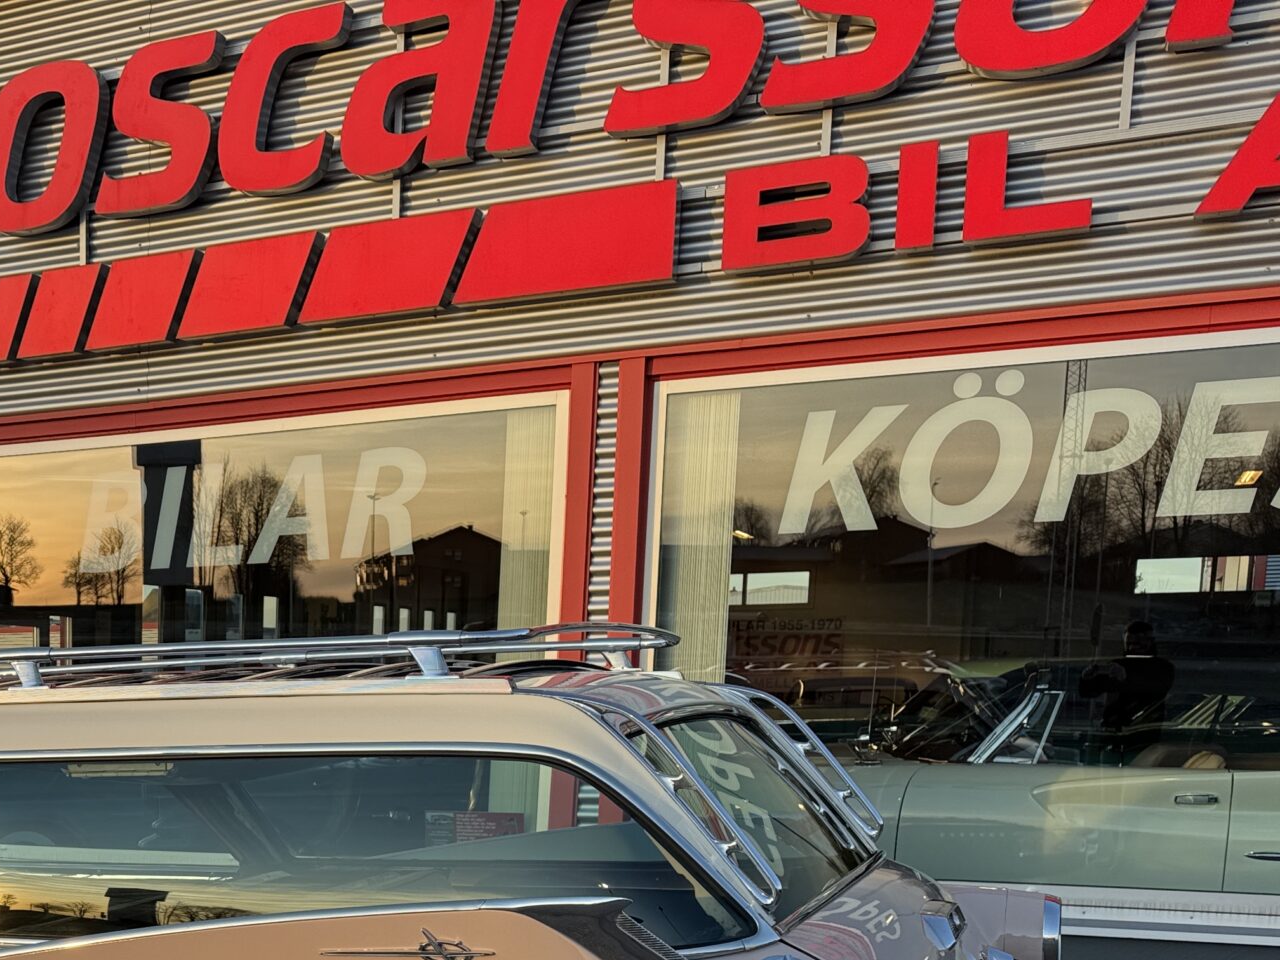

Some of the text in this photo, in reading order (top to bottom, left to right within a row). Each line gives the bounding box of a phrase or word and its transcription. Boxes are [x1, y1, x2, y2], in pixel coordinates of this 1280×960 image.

[721, 130, 1093, 271] BIL
[79, 446, 428, 574] BILAR
[778, 369, 1280, 535] KÖPE
[772, 617, 843, 632] 1955-1970
